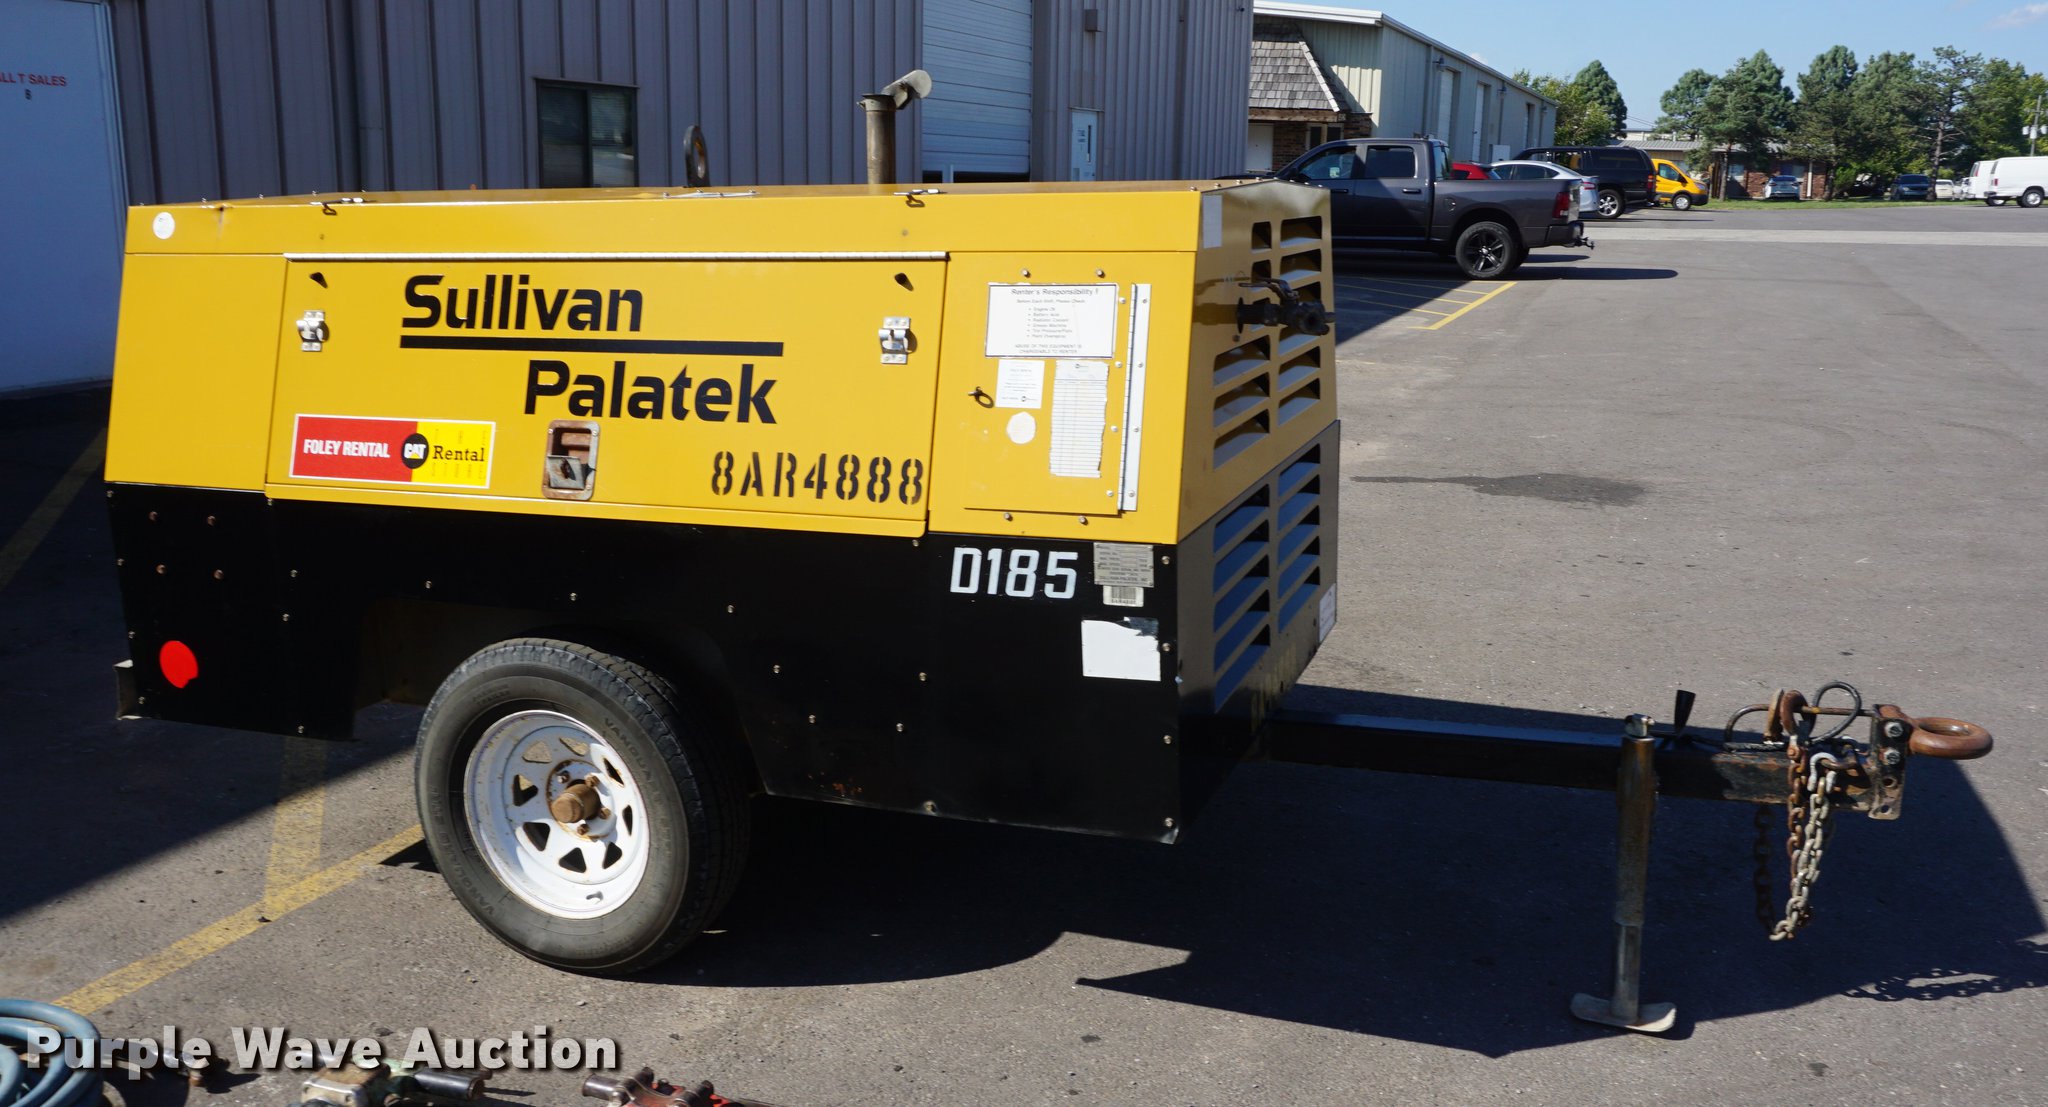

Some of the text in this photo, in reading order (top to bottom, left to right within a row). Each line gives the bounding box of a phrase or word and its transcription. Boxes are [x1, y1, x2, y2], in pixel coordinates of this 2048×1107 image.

[17, 73, 26, 84] T
[28, 73, 67, 86] SALES
[402, 274, 643, 331] Sullivan
[1042, 288, 1093, 296] Responsibility
[524, 360, 778, 424] Palatek
[303, 439, 390, 458] FOLEY RENTAL
[404, 443, 485, 462] CAT Rental
[711, 450, 924, 505] 8AR4888
[950, 547, 1078, 600] D185
